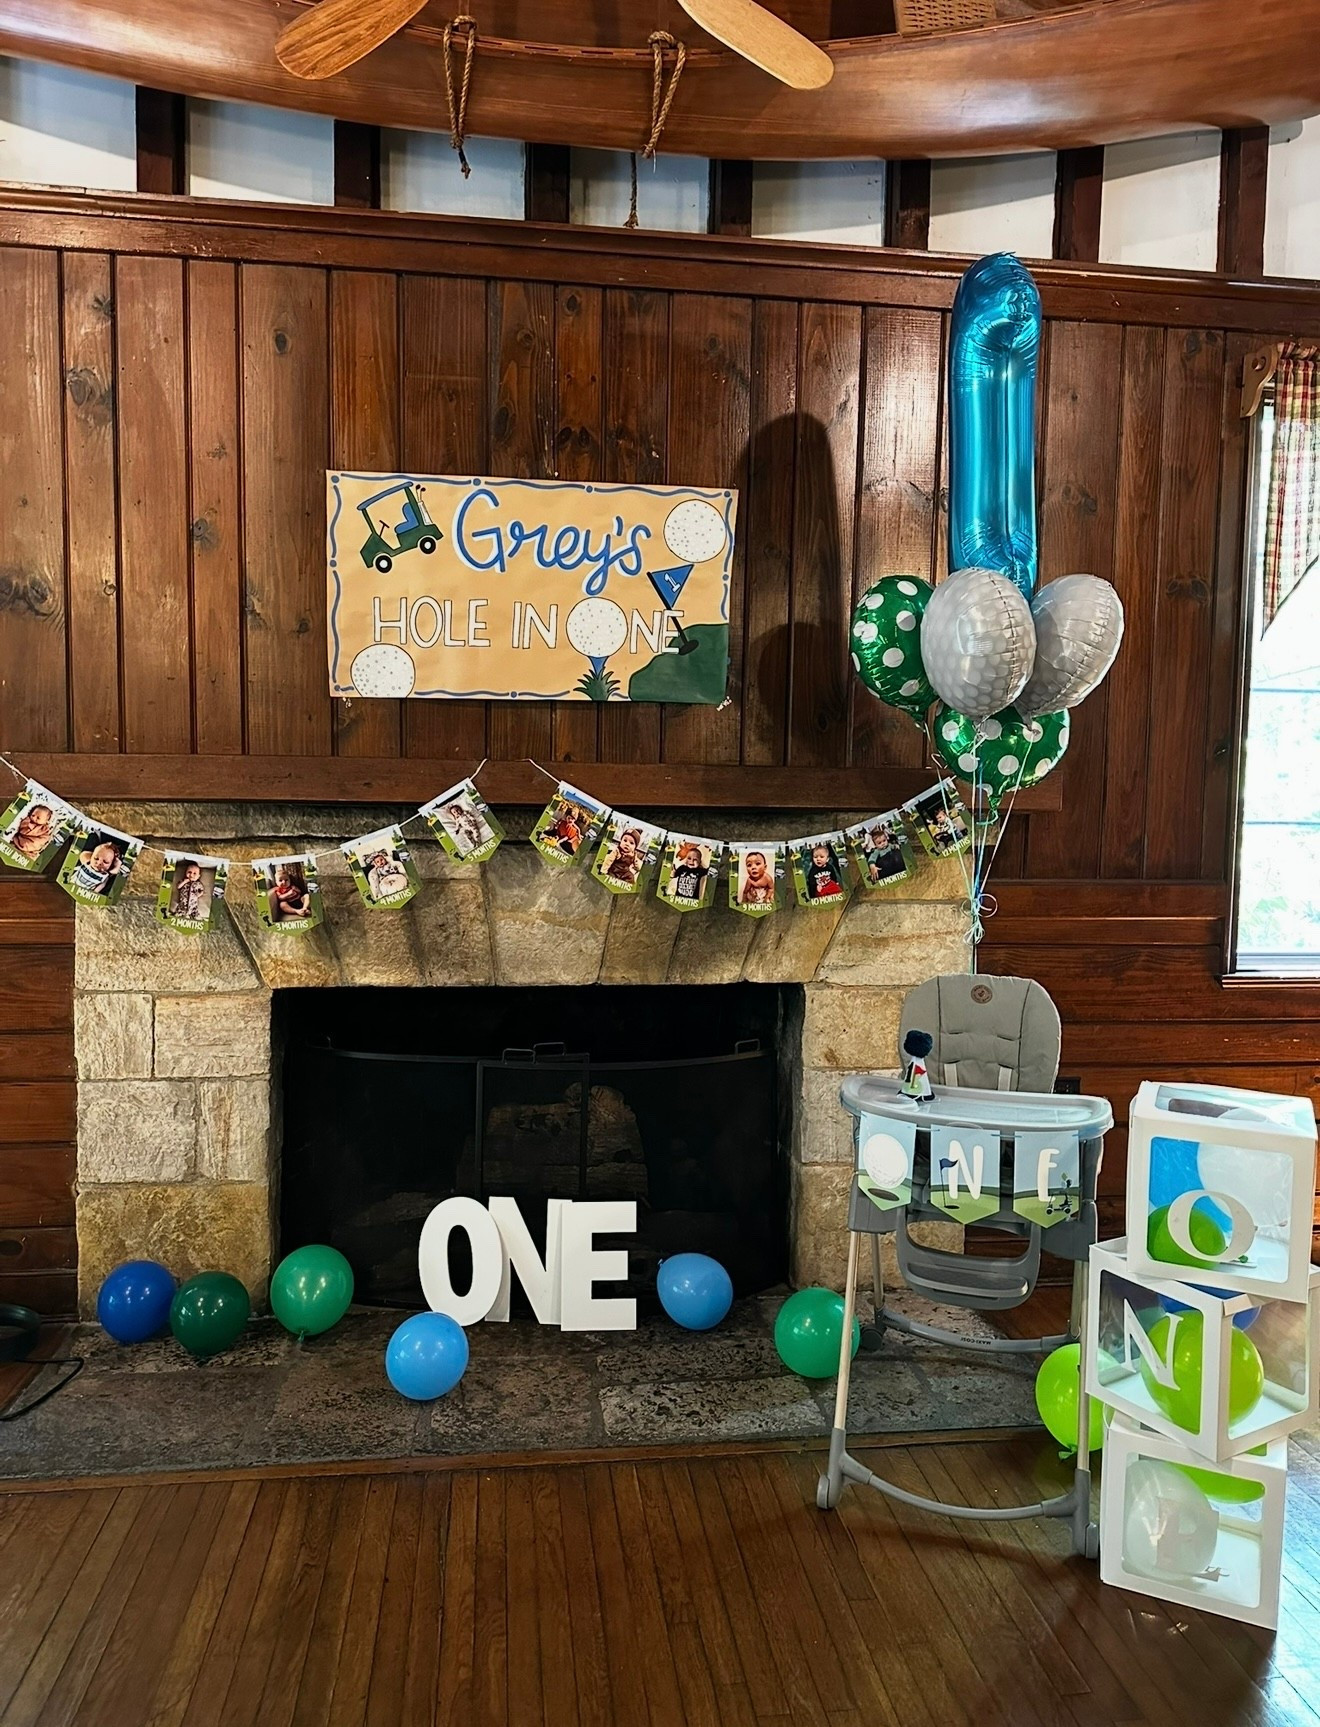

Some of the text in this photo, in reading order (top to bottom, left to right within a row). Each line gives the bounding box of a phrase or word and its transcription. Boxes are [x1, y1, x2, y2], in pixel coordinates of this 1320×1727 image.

[453, 487, 651, 595] Grey's
[664, 573, 681, 593] 1
[373, 596, 490, 648] HOLE
[512, 601, 558, 650] IN
[472, 840, 496, 860] MONTHS
[544, 846, 569, 864] MONTHS
[607, 877, 632, 891] MONTHS
[884, 871, 907, 885] MONTHS
[76, 886, 100, 903] MONTH
[386, 890, 411, 904] MONTHS
[819, 894, 843, 904] MONTHS
[674, 896, 699, 908] MONTHS
[748, 903, 772, 912] MONTHS
[176, 919, 204, 930] MONTHS
[281, 920, 308, 931] MONTHS
[418, 1196, 637, 1332] ONE
